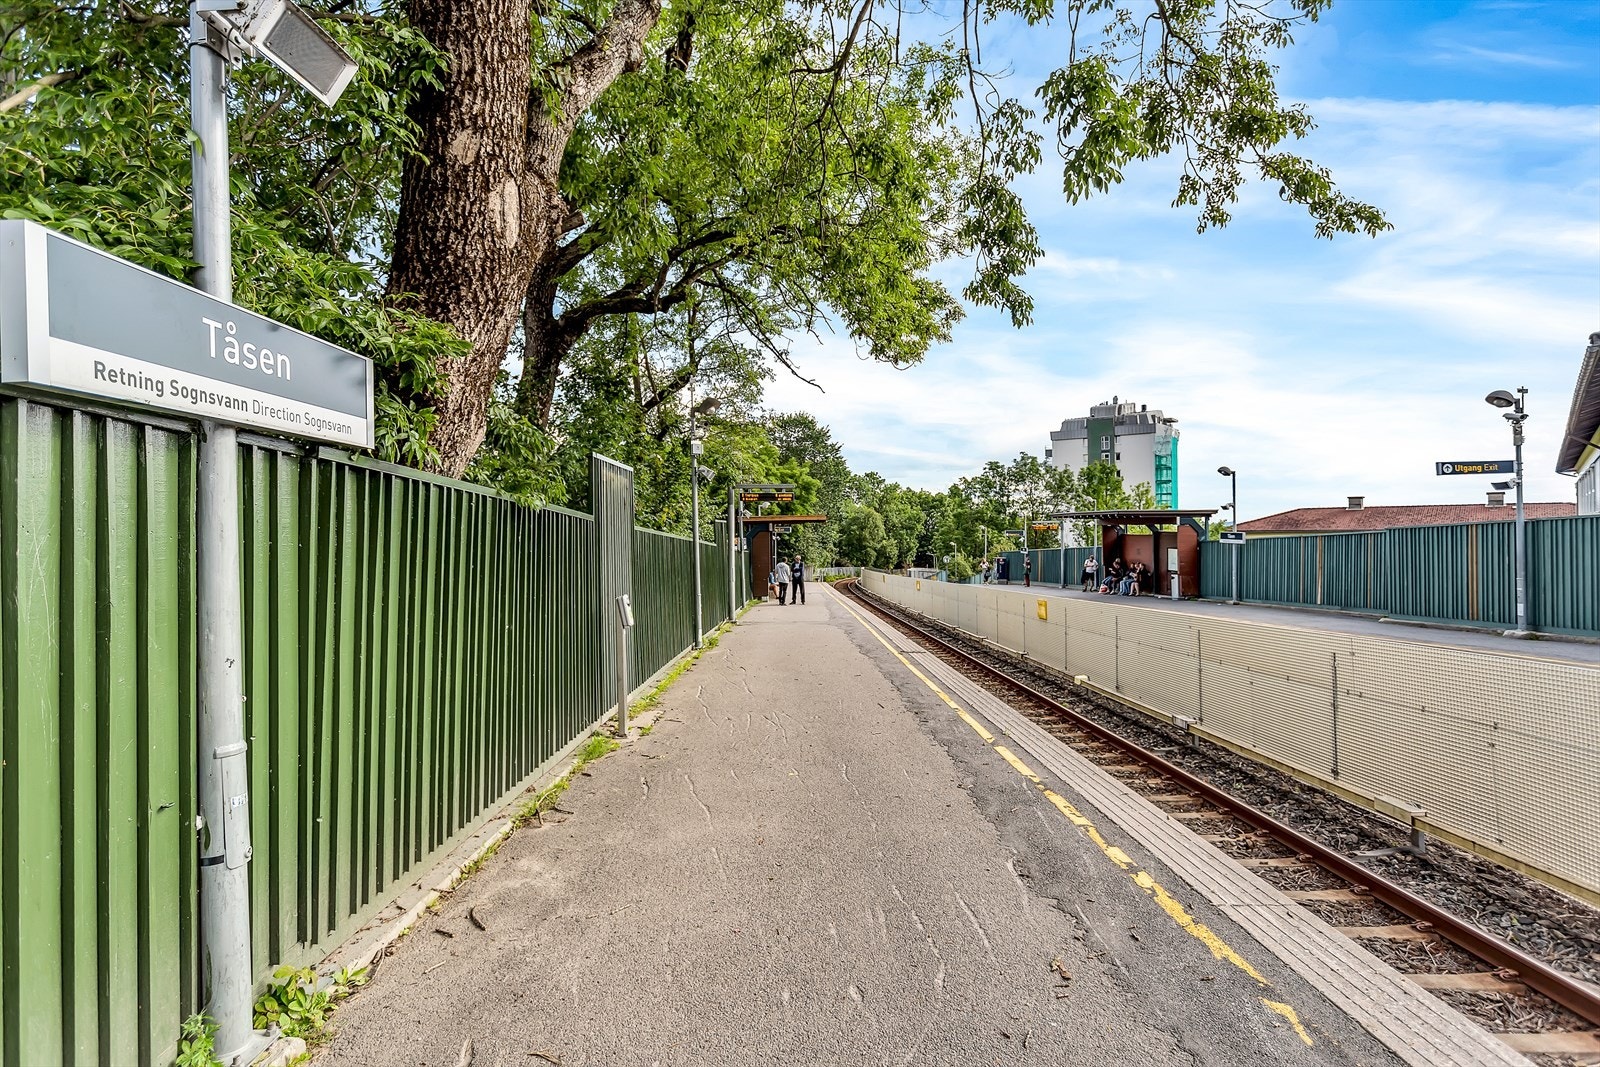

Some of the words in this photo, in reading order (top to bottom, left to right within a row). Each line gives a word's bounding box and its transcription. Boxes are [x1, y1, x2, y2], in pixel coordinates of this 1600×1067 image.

[202, 316, 292, 381] Tåsen
[93, 360, 165, 397] Retning
[169, 379, 248, 412] Sognsvann
[252, 400, 302, 424] Direction
[304, 411, 352, 435] Sognsvann
[1454, 464, 1482, 473] Utgang
[1483, 463, 1498, 471] Exit
